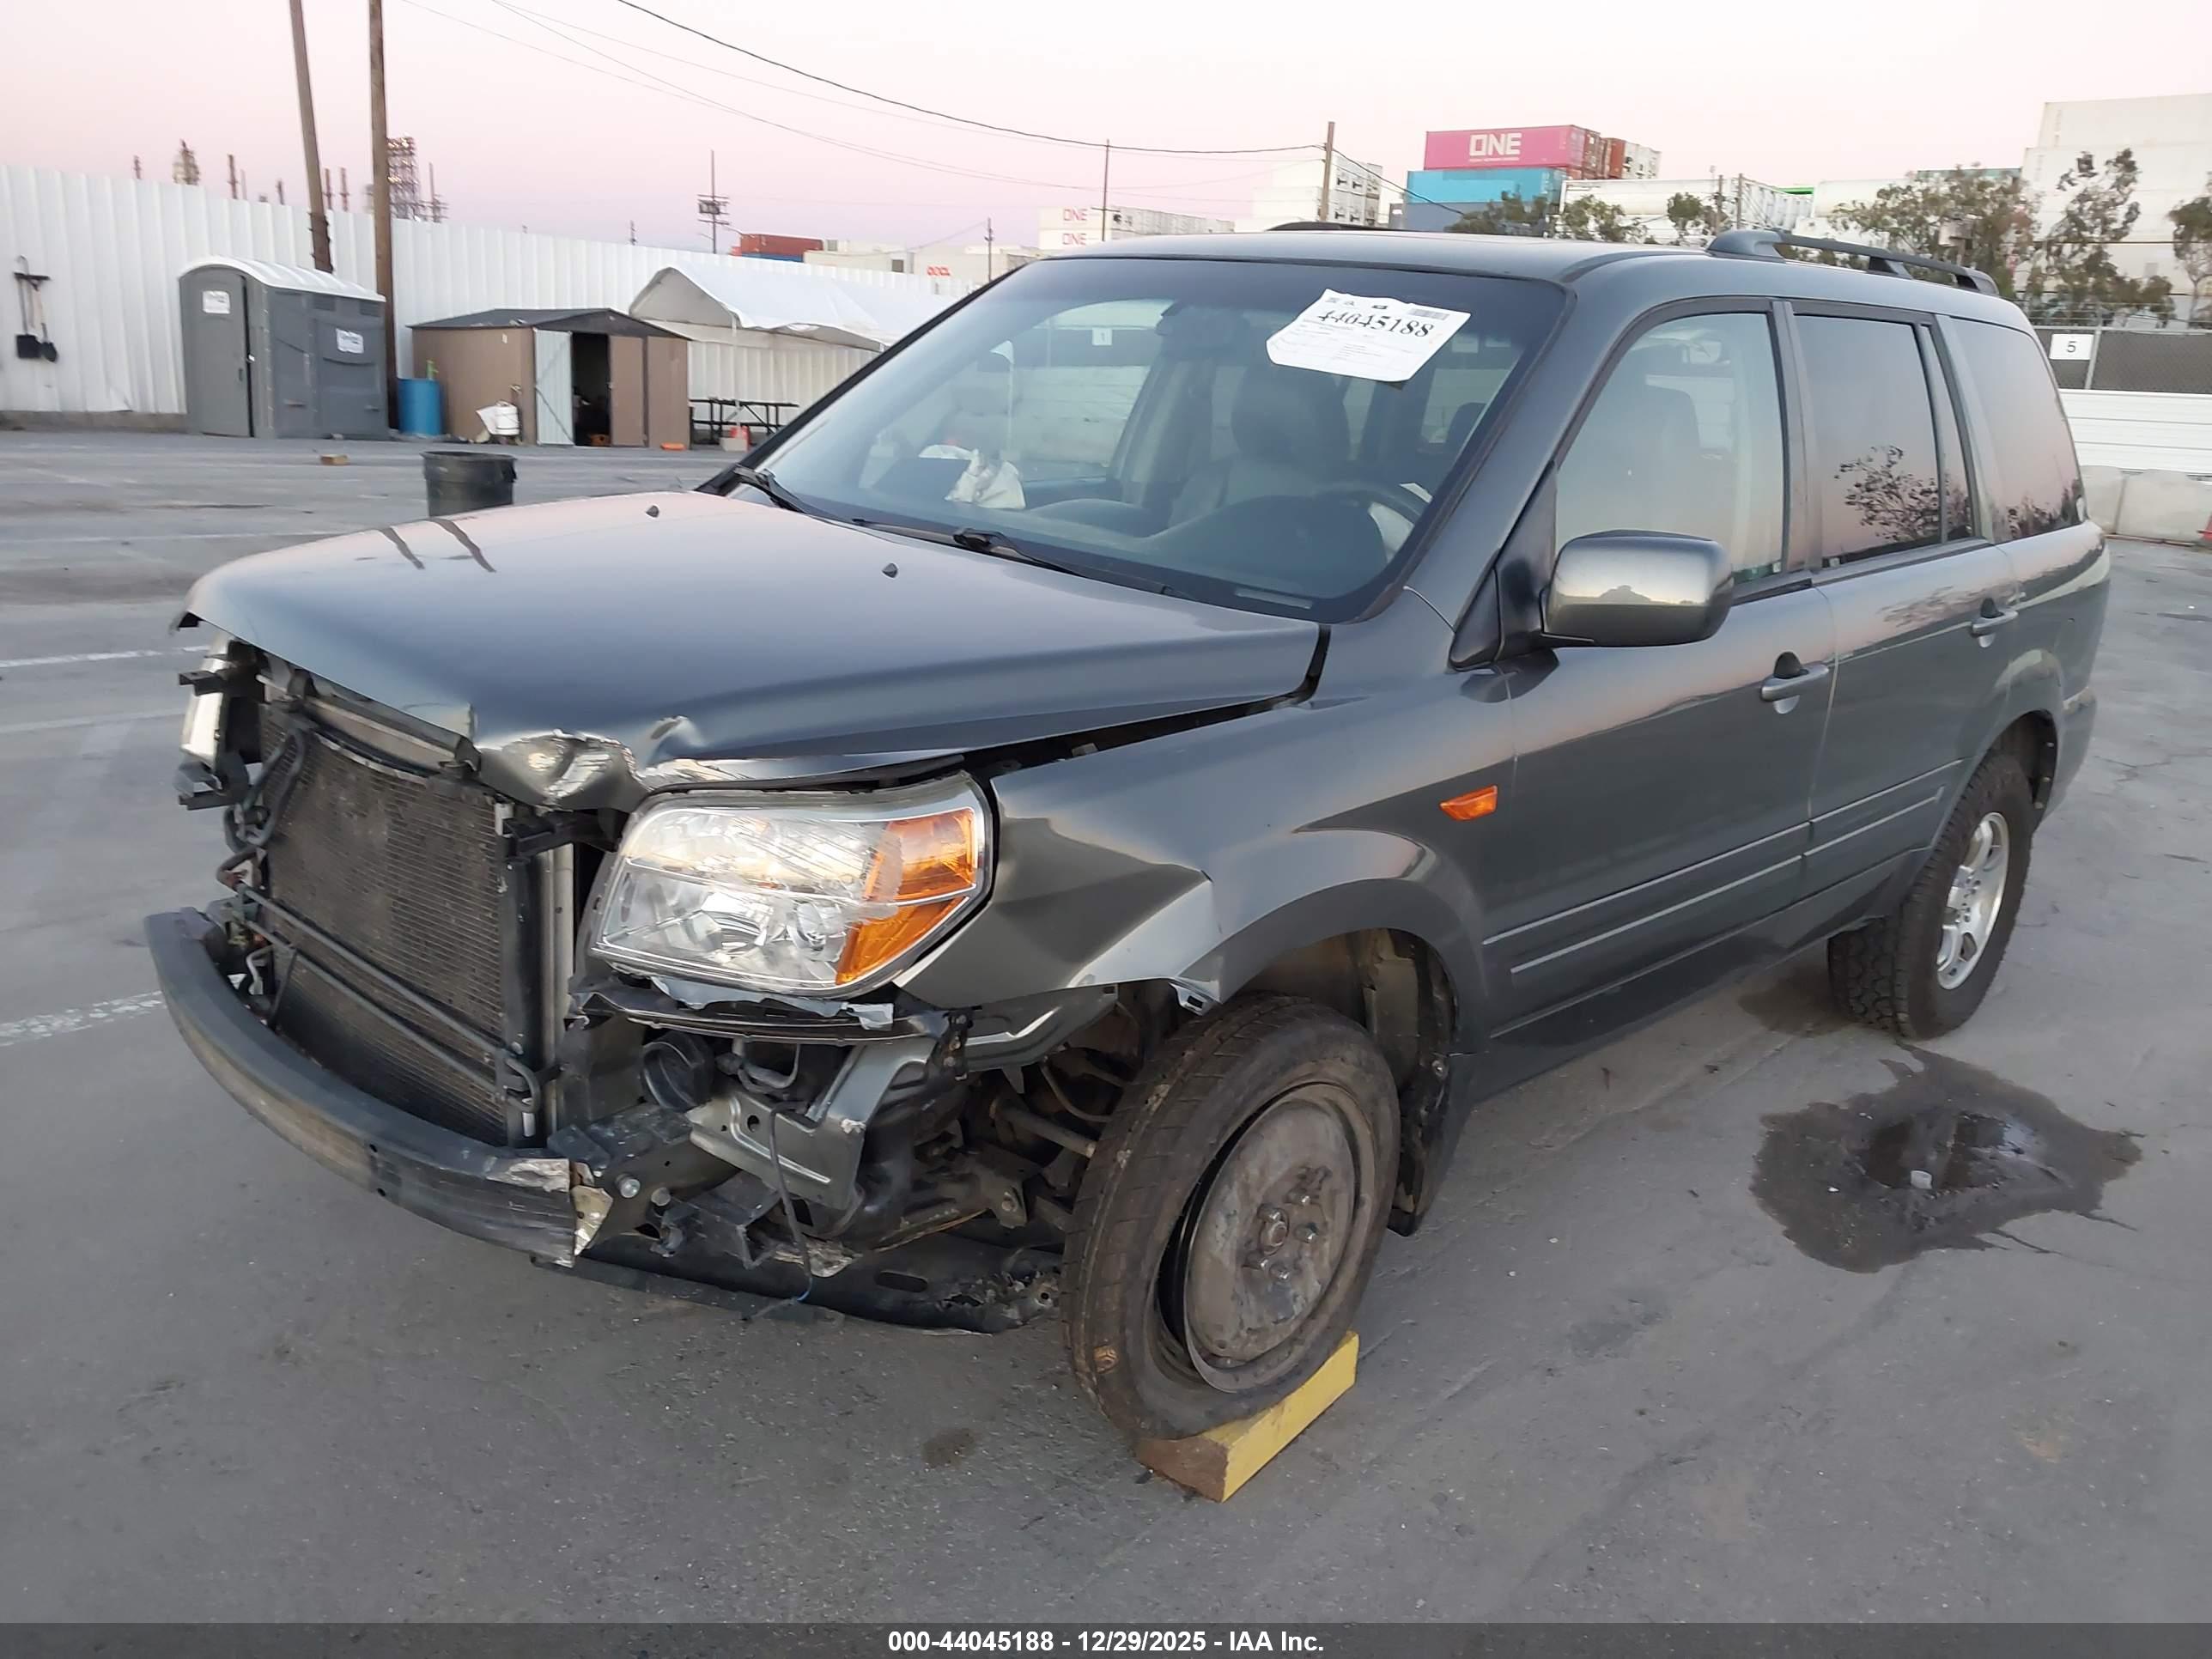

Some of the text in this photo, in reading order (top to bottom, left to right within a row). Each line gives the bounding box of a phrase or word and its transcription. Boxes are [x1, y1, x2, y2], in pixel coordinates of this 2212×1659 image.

[1469, 132, 1522, 156] ONE
[1062, 208, 1088, 221] ONE
[1062, 233, 1086, 246] ONE
[2067, 341, 2077, 353] 5
